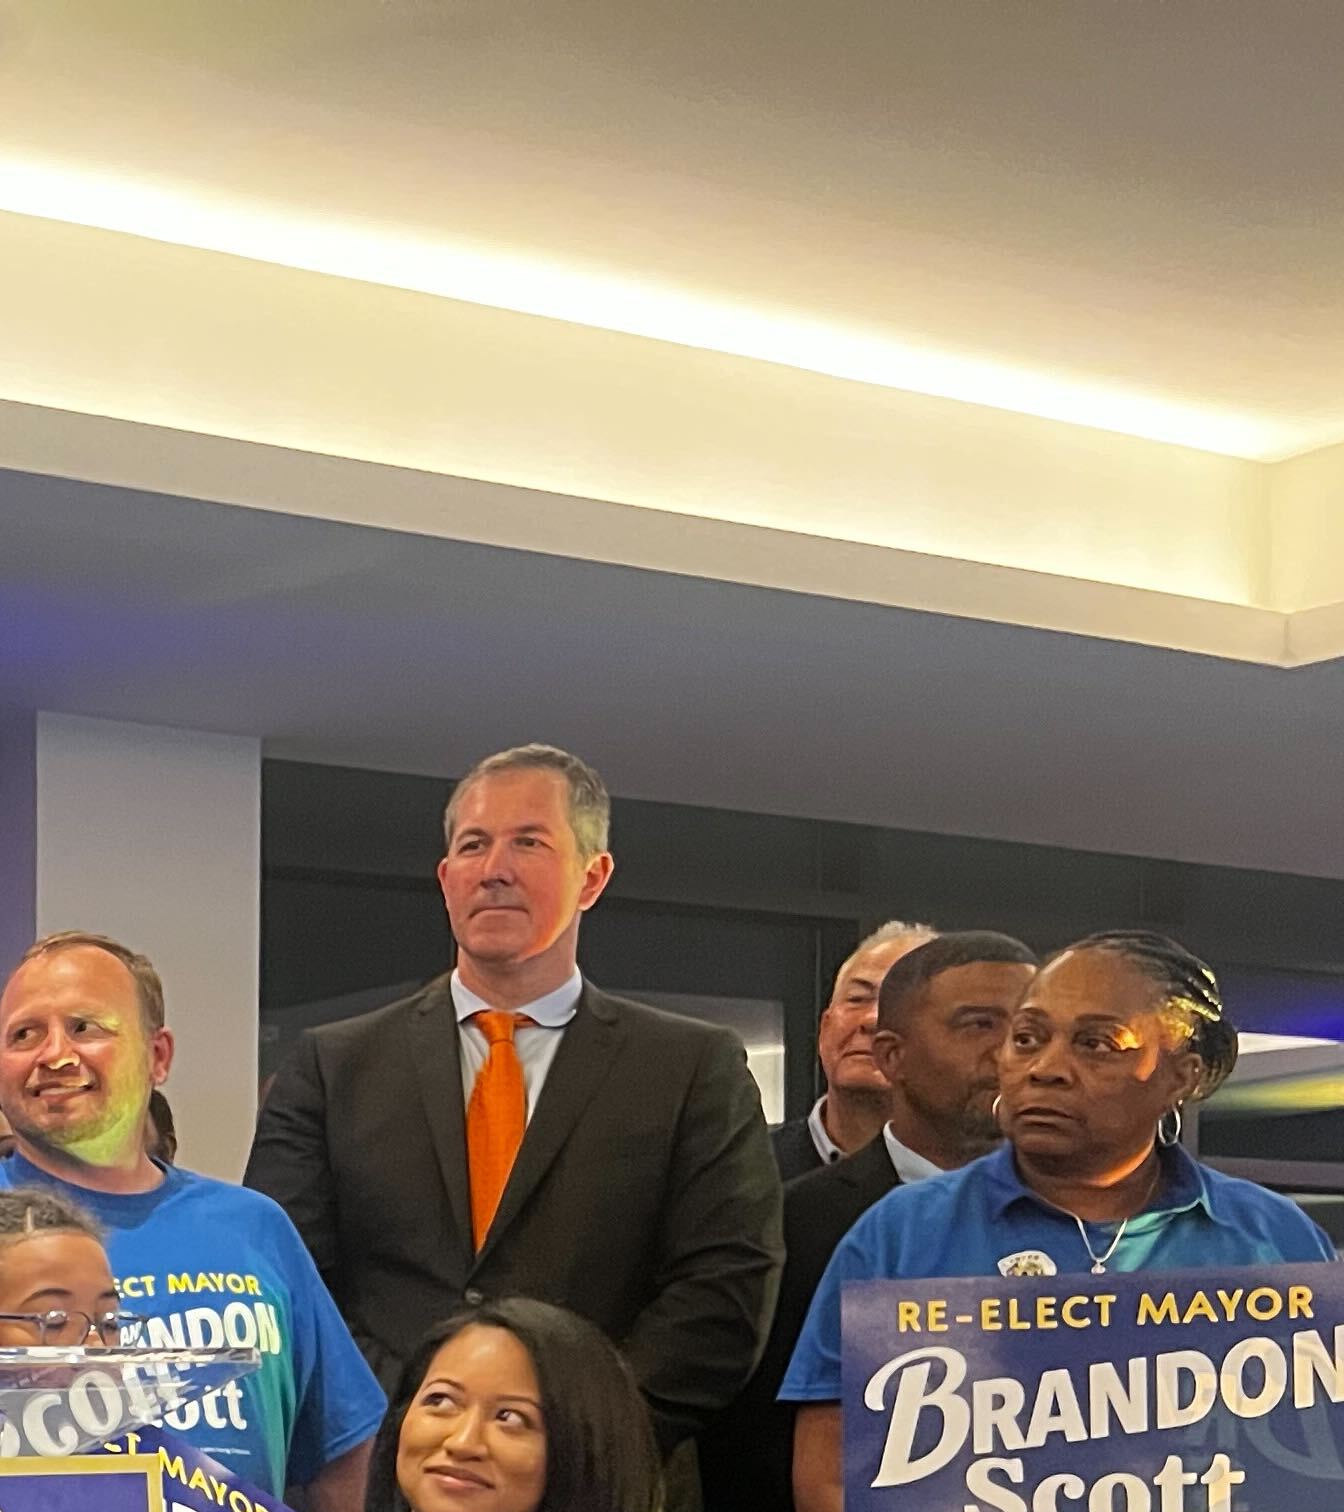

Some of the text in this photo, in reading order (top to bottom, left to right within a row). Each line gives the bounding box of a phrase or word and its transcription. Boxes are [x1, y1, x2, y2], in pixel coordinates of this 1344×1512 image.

[168, 1272, 263, 1297] MAYOR
[897, 1285, 1315, 1333] RE-ELECT MAYOR
[142, 1301, 282, 1366] NDON
[864, 1324, 1344, 1488] BRANDON
